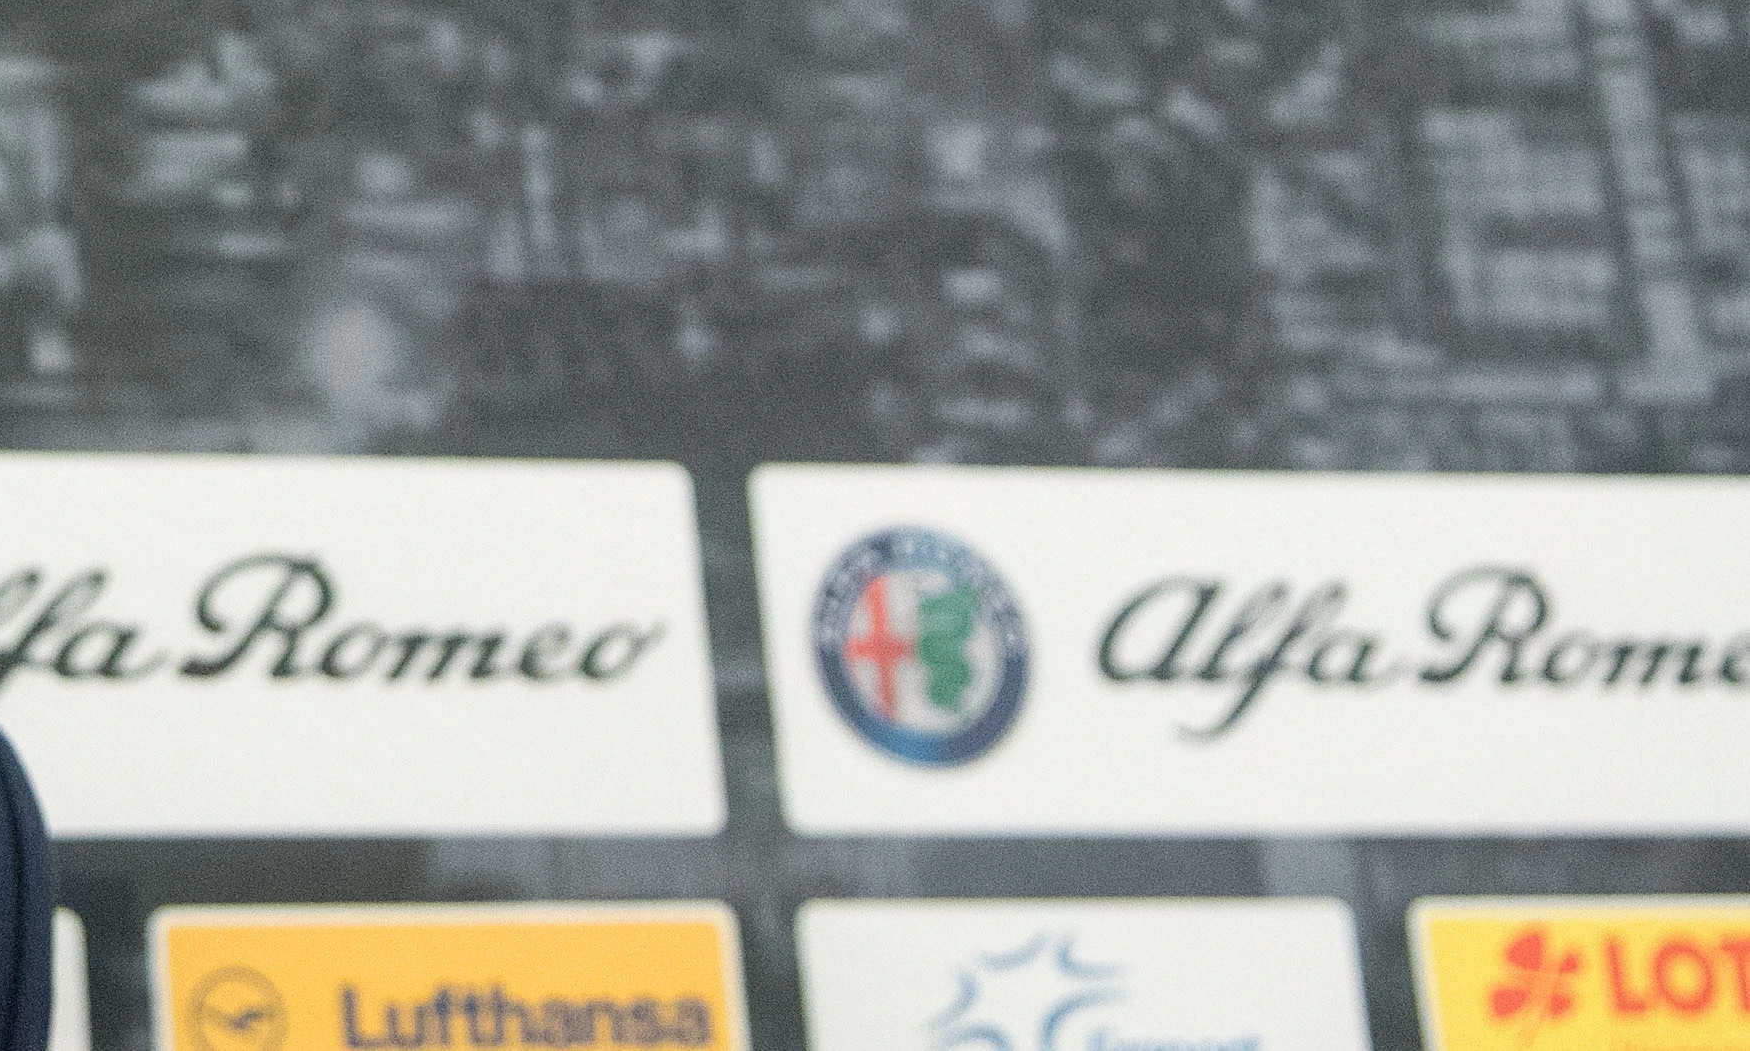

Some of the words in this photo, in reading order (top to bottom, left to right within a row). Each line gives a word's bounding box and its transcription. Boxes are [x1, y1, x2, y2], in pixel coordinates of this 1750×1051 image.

[178, 551, 668, 686] Romeo
[1096, 572, 1395, 747] Alfa
[339, 981, 714, 1051] Lufthansa
